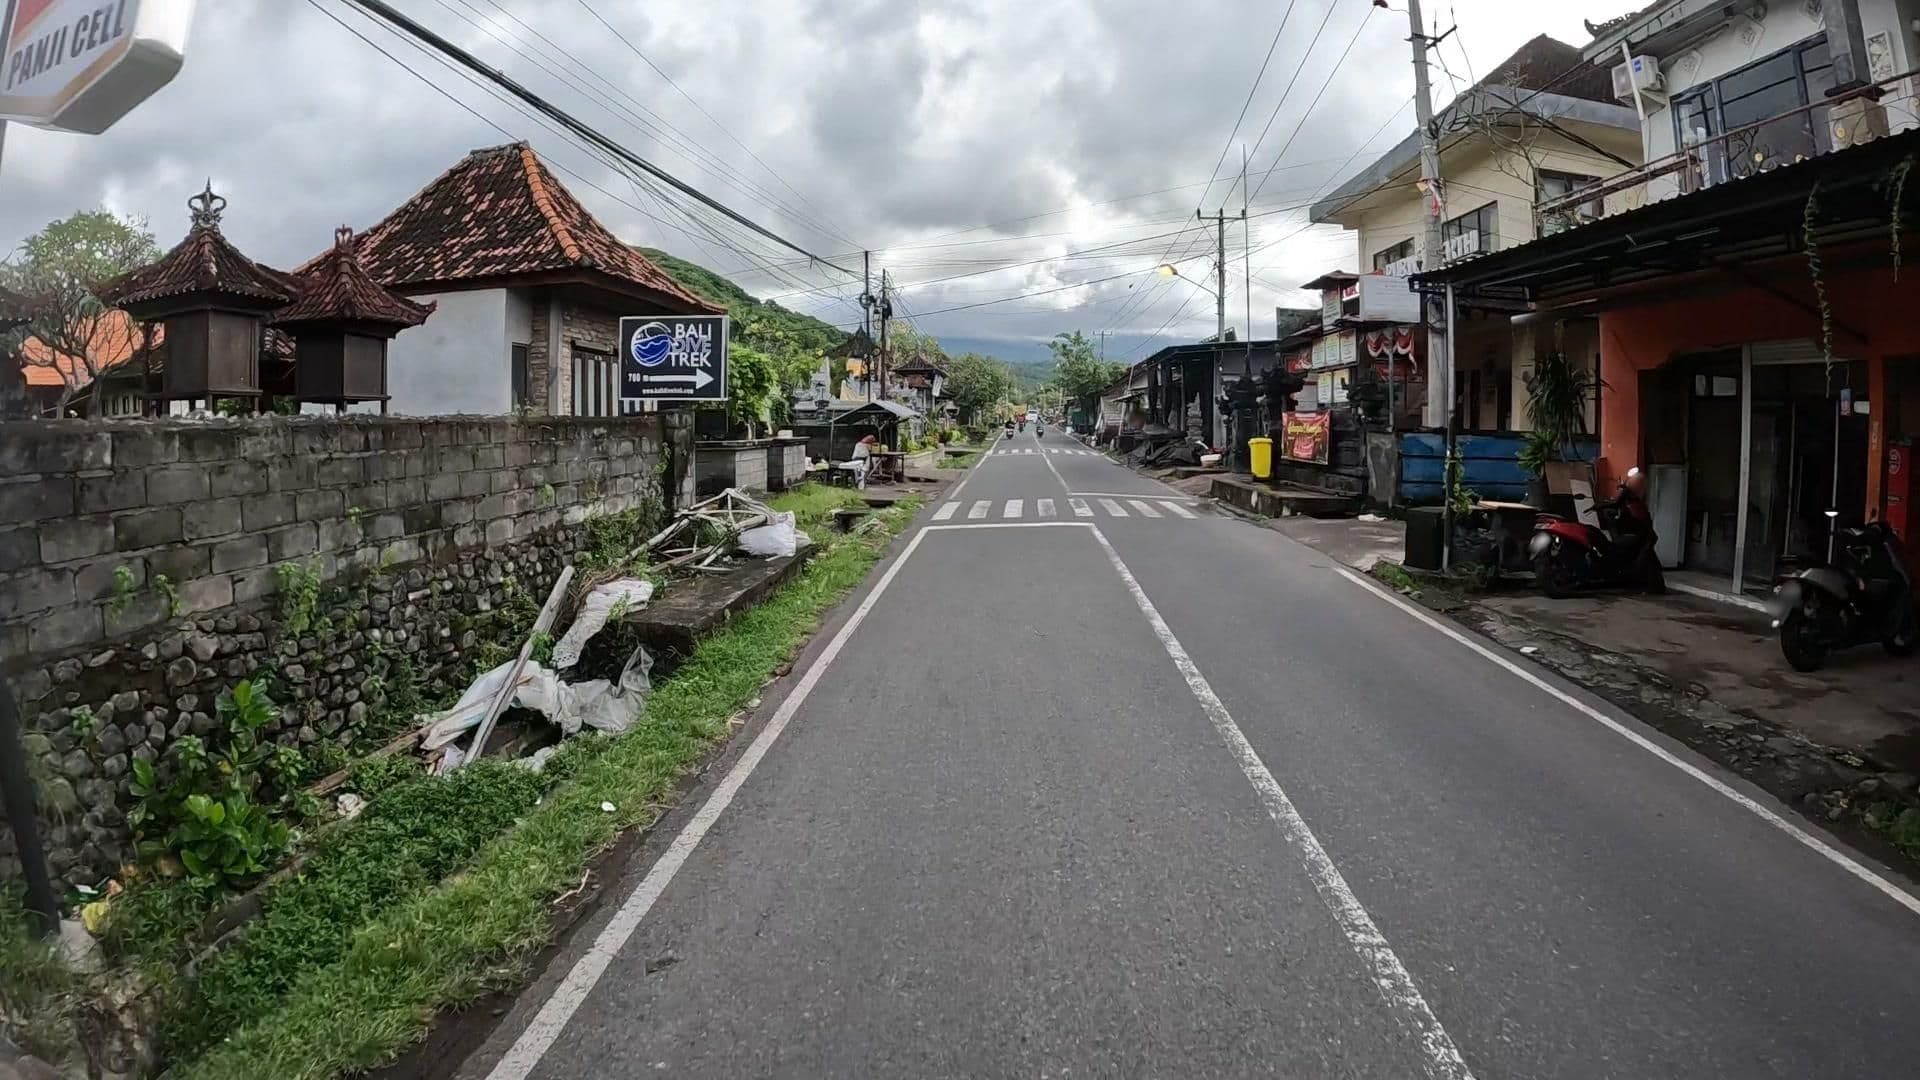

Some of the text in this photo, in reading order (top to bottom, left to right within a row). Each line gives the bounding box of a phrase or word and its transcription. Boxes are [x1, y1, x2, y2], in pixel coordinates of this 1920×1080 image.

[6, 0, 126, 91] PANJI CELL
[675, 323, 712, 340] BALI
[672, 338, 712, 353] DIVE
[670, 352, 712, 367] TREK
